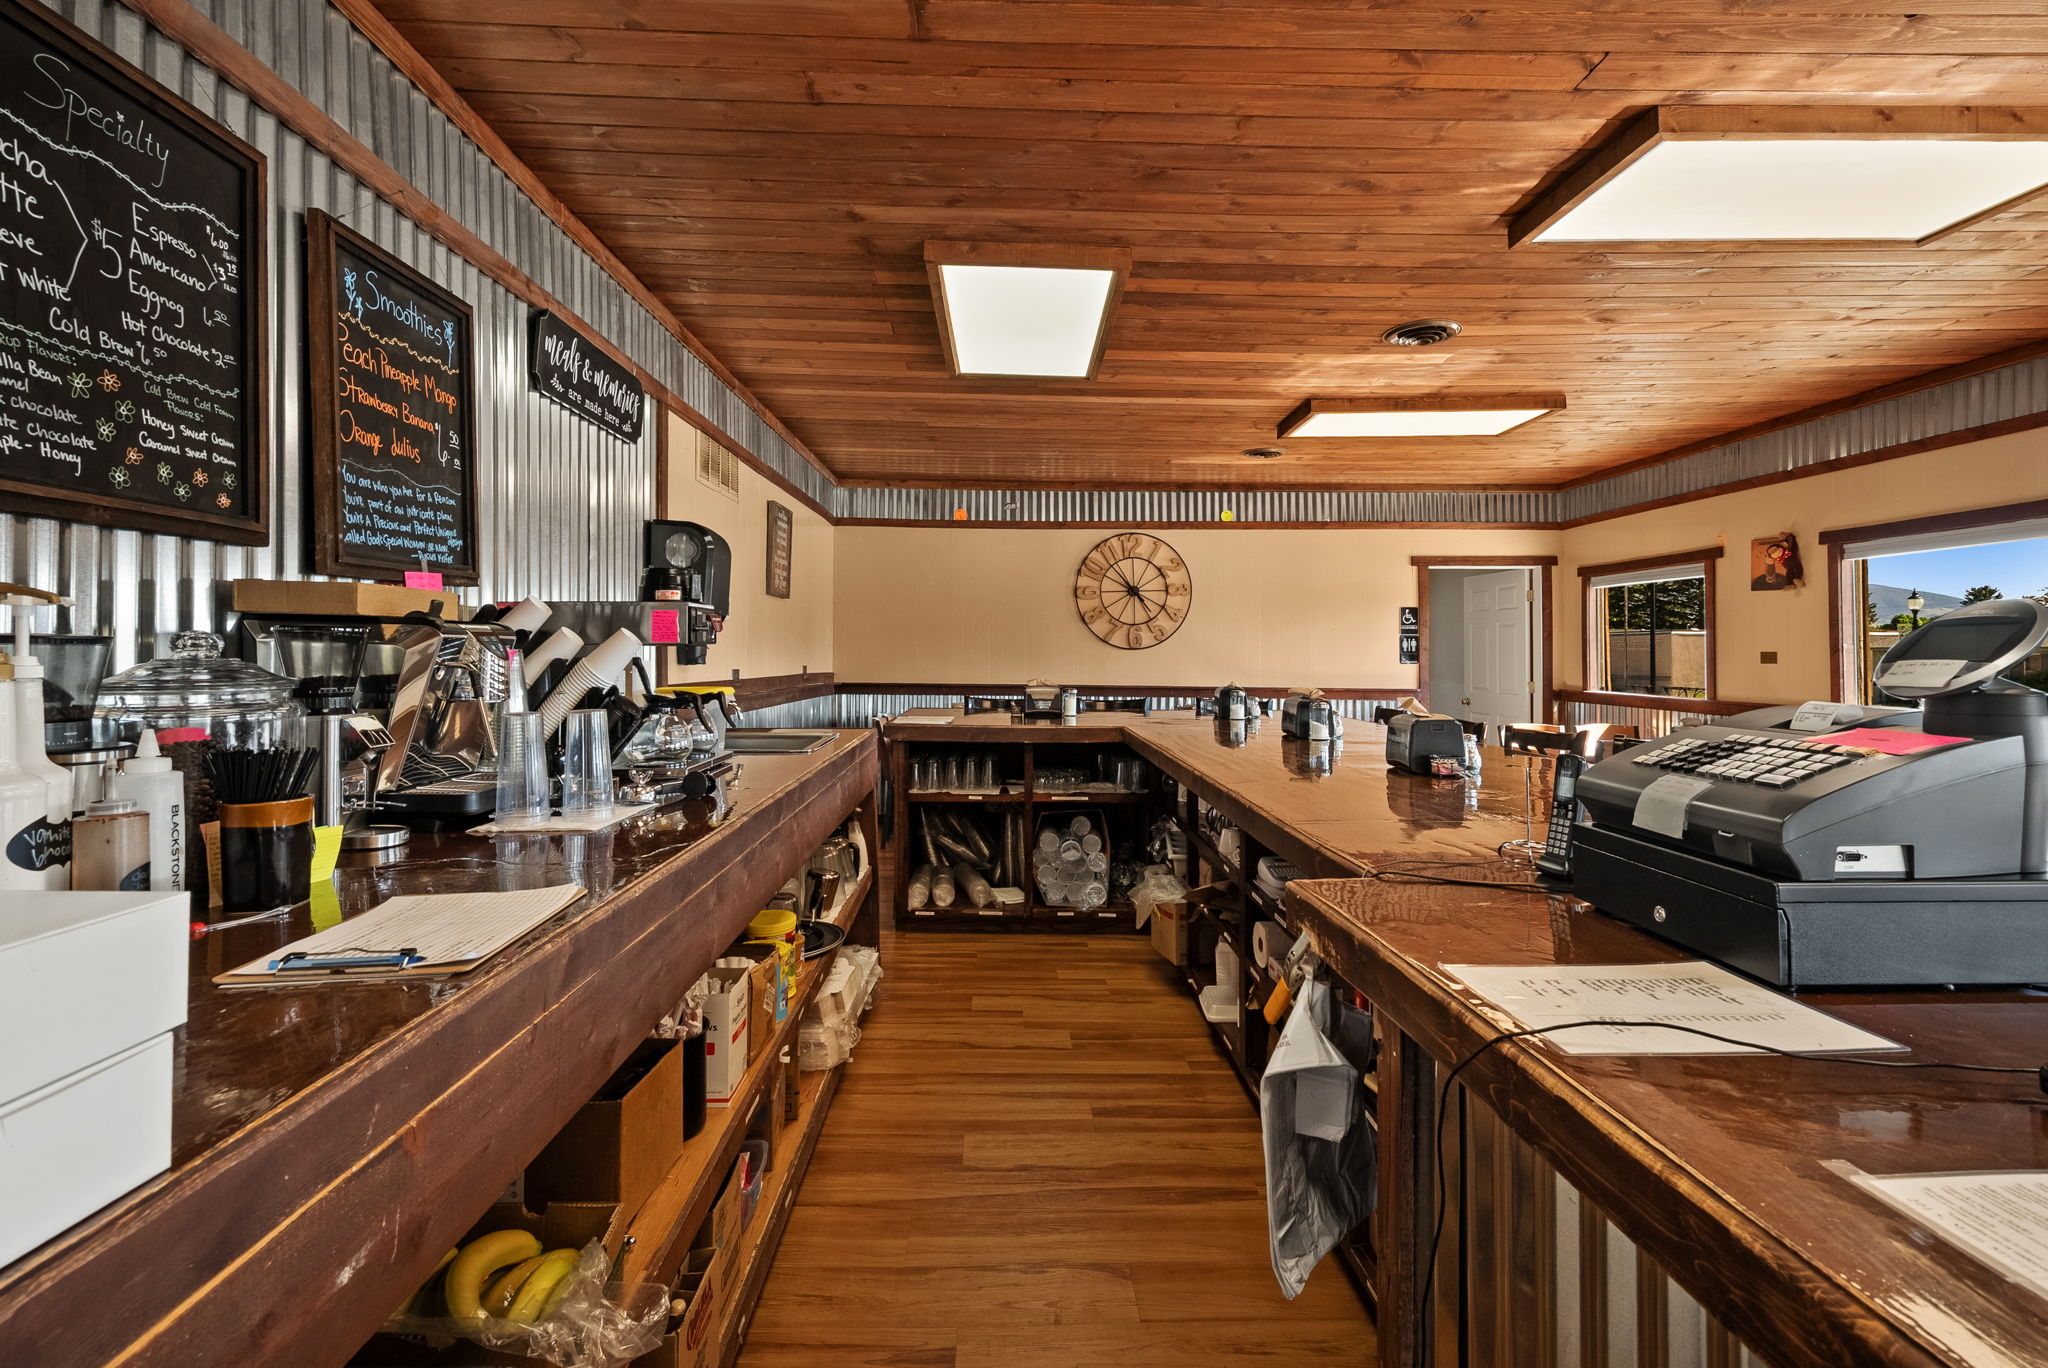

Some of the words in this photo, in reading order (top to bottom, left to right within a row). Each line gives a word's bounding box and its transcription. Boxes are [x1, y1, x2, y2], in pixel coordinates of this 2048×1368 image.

[23, 53, 169, 188] Specialty
[0, 137, 53, 186] cha
[132, 201, 197, 259] Espresso
[130, 237, 206, 292] Americano
[128, 268, 185, 328] Eggnog
[365, 270, 443, 346] Smoothies
[50, 306, 92, 345] Cold
[99, 331, 134, 358] Brew
[121, 310, 147, 336] Hot
[152, 325, 211, 362] Chocolate
[28, 358, 62, 385] Bean
[375, 347, 422, 396] Pineapple
[424, 373, 457, 415] Mango
[582, 358, 593, 383] &
[143, 380, 162, 397] Cold
[194, 397, 212, 413] Cold
[568, 388, 582, 404] are
[584, 398, 602, 416] made
[604, 407, 620, 427] here
[141, 408, 176, 440] Honey
[402, 402, 436, 436] Banana
[41, 441, 81, 477] Honey
[139, 430, 181, 456] Caramel
[391, 427, 421, 464] Julius
[1117, 533, 1143, 558] 12
[1147, 540, 1163, 561] 1
[1159, 557, 1184, 579] 2
[1127, 625, 1144, 649] 6
[171, 804, 181, 891] BLACKSTONE
